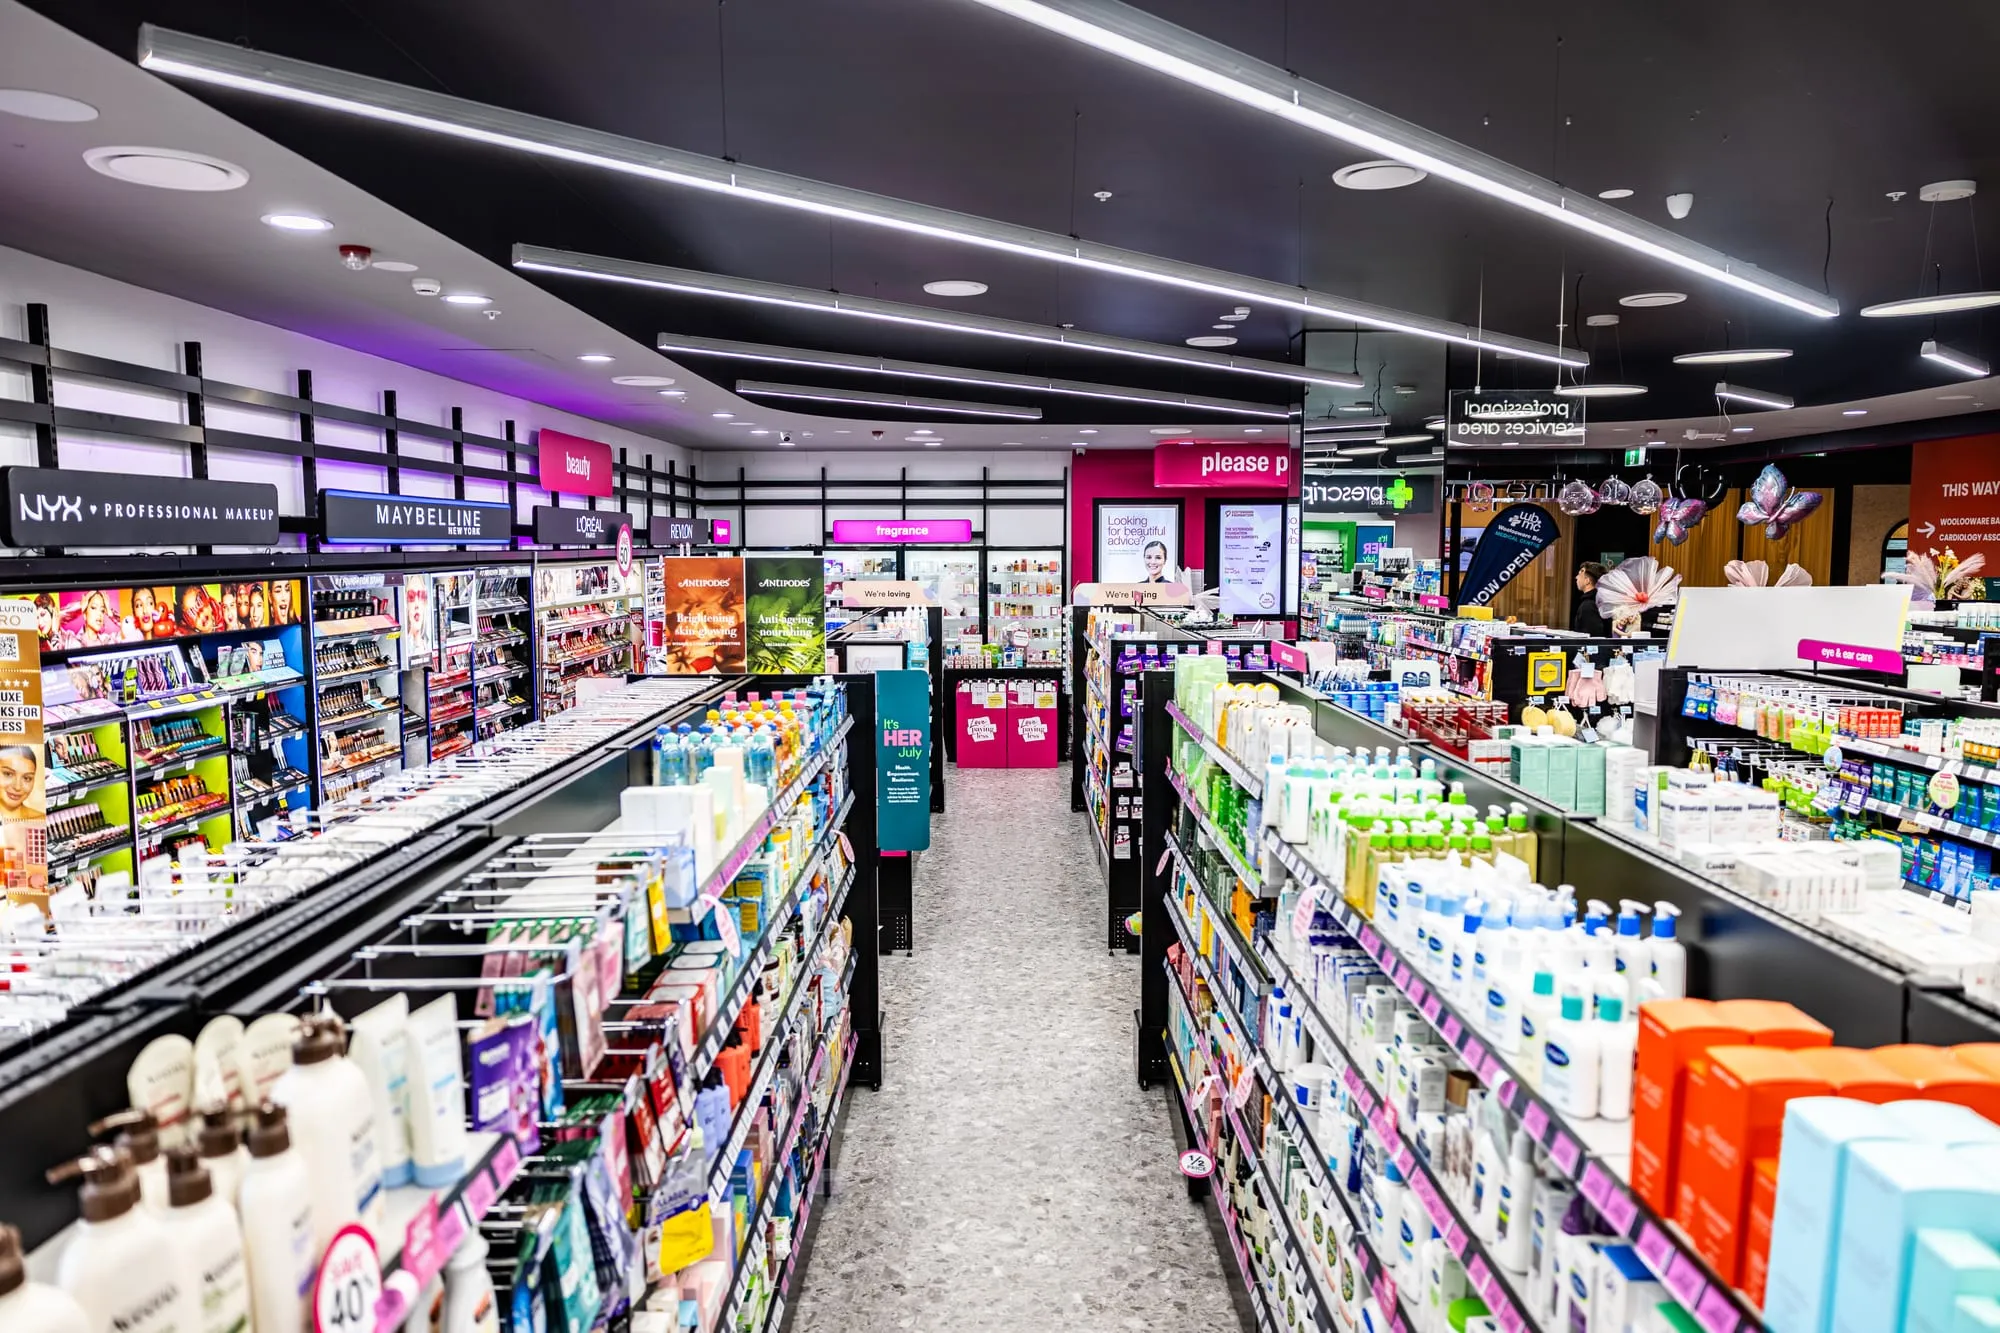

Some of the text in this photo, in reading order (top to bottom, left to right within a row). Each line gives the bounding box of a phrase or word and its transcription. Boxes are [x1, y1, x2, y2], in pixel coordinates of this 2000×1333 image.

[566, 451, 591, 481] beauty
[1202, 452, 1269, 477] please
[1942, 481, 2000, 497] THIS WAY
[19, 493, 274, 523] NYX PROFESSIONAL MAKEUP
[376, 504, 481, 526] MAYBELLINE
[1940, 516, 1990, 526] WOOLOOWARE
[1107, 516, 1148, 528] Looking
[447, 526, 481, 536] NEW YORK
[670, 523, 694, 539] REVLON
[876, 525, 929, 537] fragrance
[1107, 526, 1166, 536] for beautiful
[1107, 536, 1146, 546] advice?
[1531, 535, 1544, 544] Bay
[1939, 533, 1982, 542] CARDIOLOGY
[1499, 548, 1535, 582] OPEN
[864, 590, 911, 600] We're loving
[1105, 590, 1130, 599] We're
[676, 612, 735, 626] Brightening
[760, 626, 813, 639] nourishing
[1821, 647, 1873, 663] eye & ear care
[0, 707, 38, 719] KS FOR
[883, 718, 900, 730] It's
[883, 729, 922, 746] HER
[898, 747, 922, 760] July
